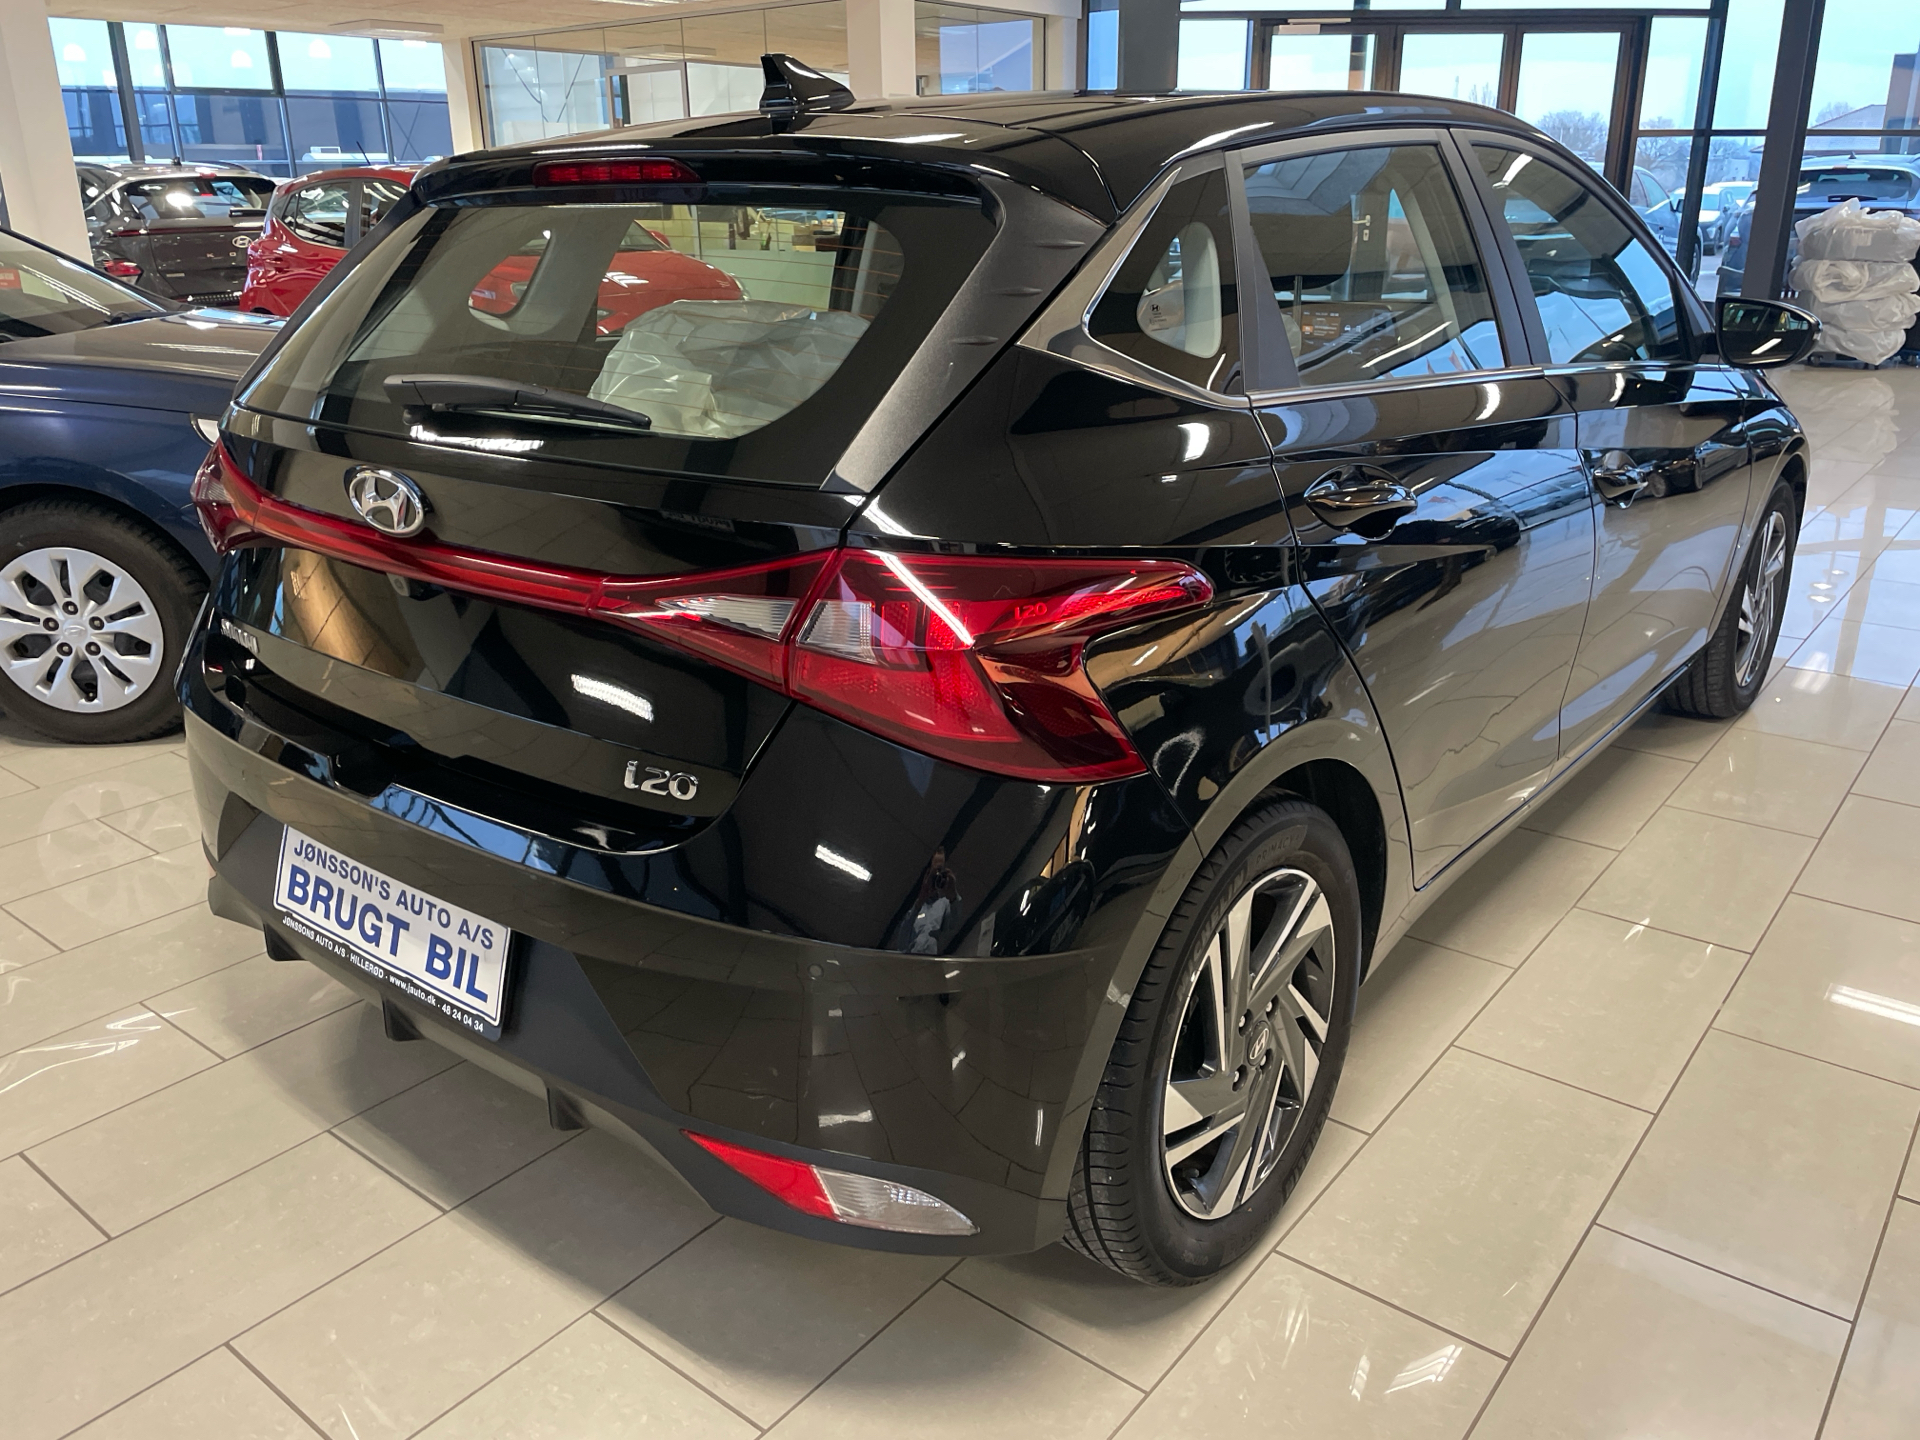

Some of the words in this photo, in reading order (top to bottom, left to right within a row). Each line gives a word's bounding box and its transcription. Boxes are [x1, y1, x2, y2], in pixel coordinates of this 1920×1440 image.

[1014, 602, 1048, 620] i20
[623, 760, 698, 800] i20
[287, 863, 410, 958] BRUGT
[425, 932, 489, 1004] BIL
[293, 839, 391, 901] JØNSSON'S
[395, 889, 451, 929] AUTO
[457, 918, 494, 950] A/S
[1176, 868, 1245, 1003] MICHELIN
[315, 933, 333, 950] AUTO
[333, 945, 346, 958] A/S
[350, 952, 384, 979] HILLERØD
[389, 974, 436, 1008] www.jauto.dk
[441, 1003, 451, 1016] 48
[452, 1008, 462, 1021] 24
[463, 1014, 472, 1027] 04
[473, 1020, 484, 1033] 34
